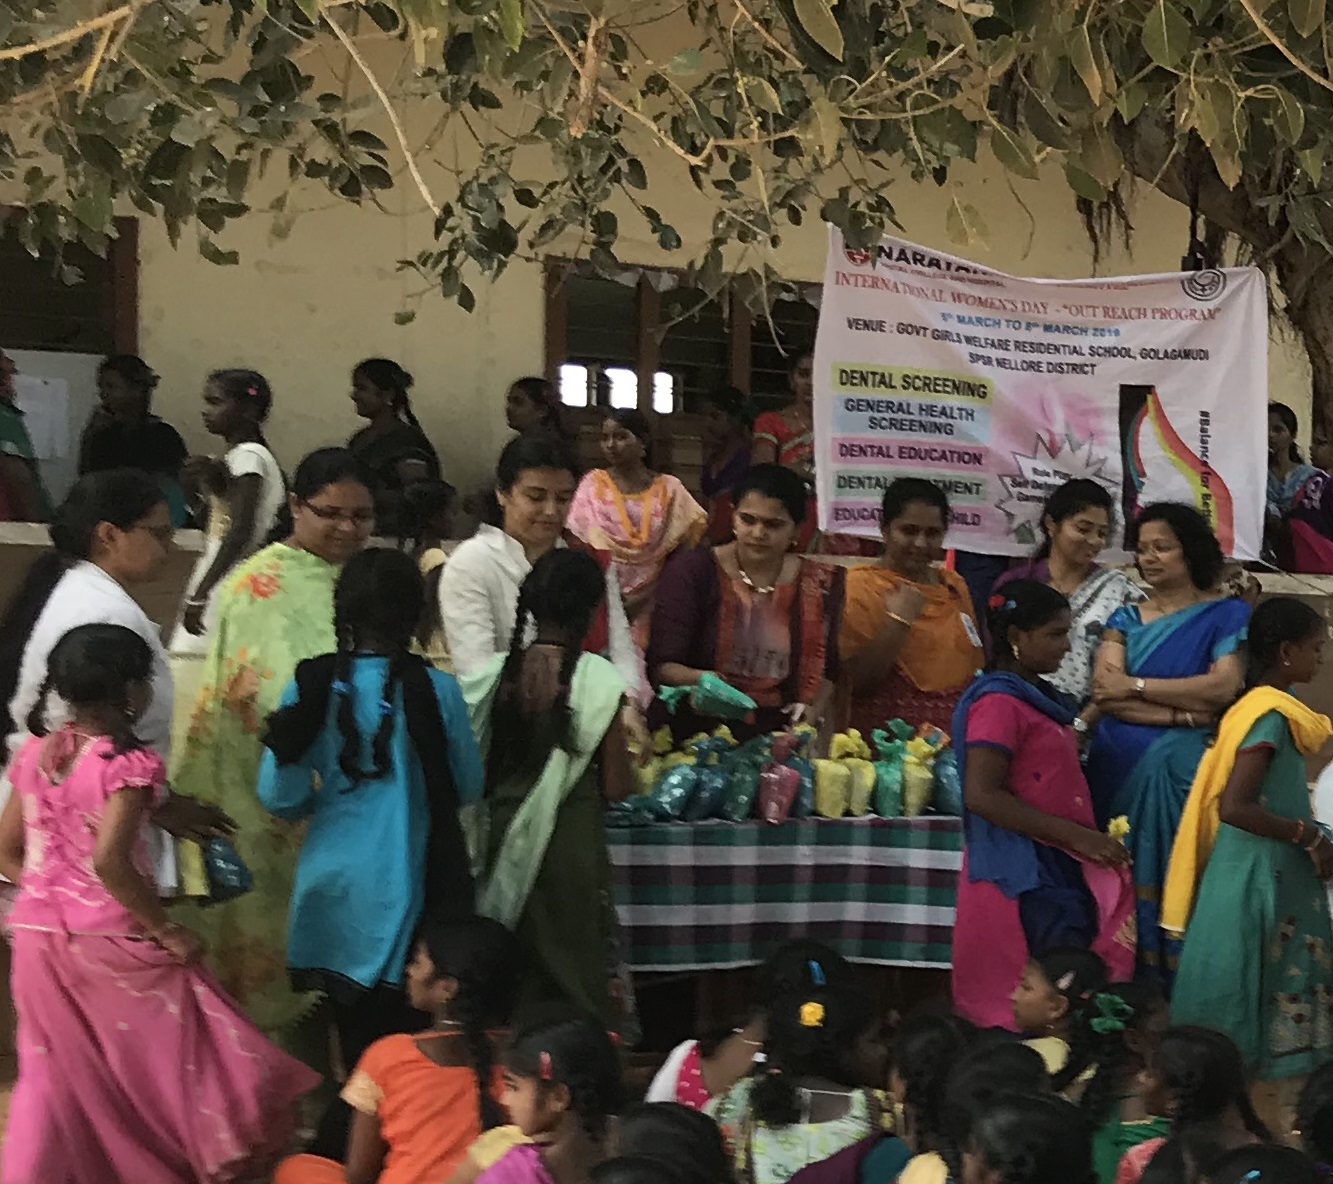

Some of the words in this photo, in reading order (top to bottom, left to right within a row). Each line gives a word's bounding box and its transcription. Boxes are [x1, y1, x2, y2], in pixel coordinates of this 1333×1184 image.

[834, 271, 949, 303] INTERNATIONAL
[950, 290, 1018, 313] WOMEN'S
[1020, 301, 1049, 315] DAY
[1102, 306, 1148, 320] REACH
[955, 313, 1002, 329] MARCH
[1004, 318, 1023, 331] TO
[1042, 322, 1089, 336] MARCH
[846, 316, 887, 333] VENUE
[895, 322, 930, 338] GOVT
[930, 326, 962, 344] GIRLS
[963, 333, 1011, 352] WELFARE
[1013, 340, 1085, 358] RESIDENTIAL
[1088, 345, 1138, 360] SCHOOL,
[995, 357, 1043, 374] NELLORE
[1046, 362, 1098, 376] DISTRICT
[839, 368, 898, 390] DENTAL
[901, 373, 988, 400] SCREENING
[844, 397, 915, 416] GENERAL
[917, 403, 976, 422] HEALTH
[868, 415, 955, 436] SCREENING
[838, 442, 895, 459] DENTAL
[897, 445, 984, 466] EDUCATION
[836, 474, 890, 490] DENTAL
